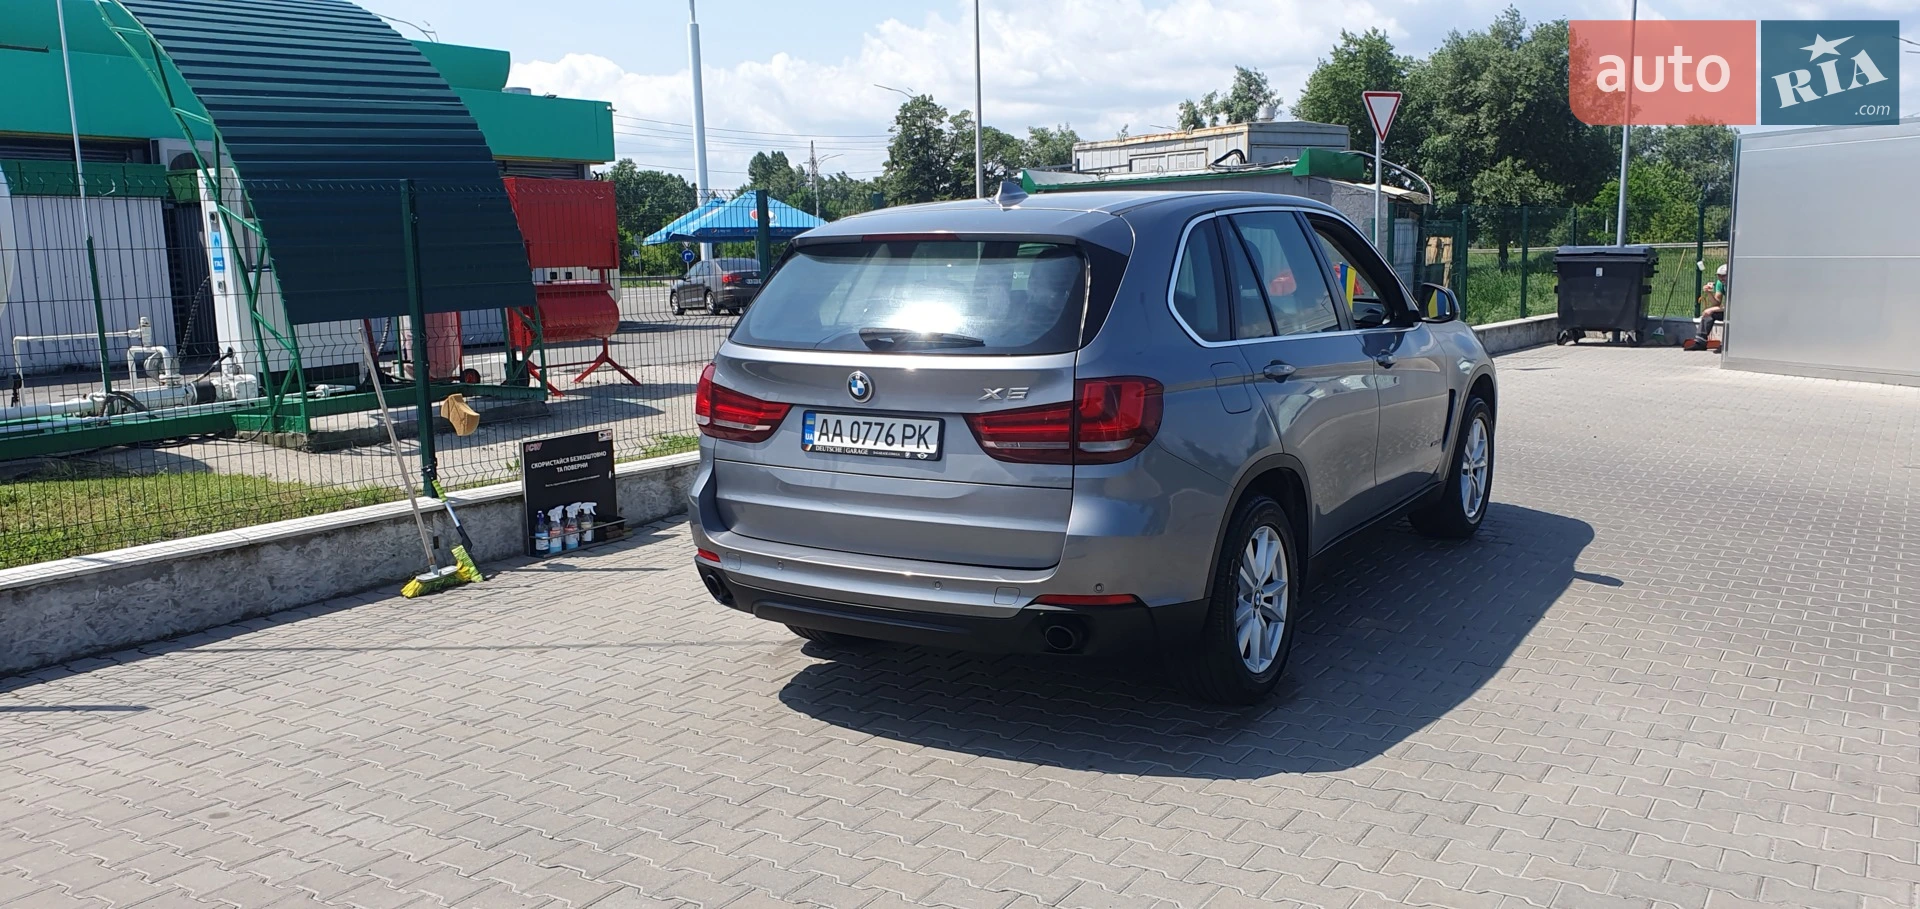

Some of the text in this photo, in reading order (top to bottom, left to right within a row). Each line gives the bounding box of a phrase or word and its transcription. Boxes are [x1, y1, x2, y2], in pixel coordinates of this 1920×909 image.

[977, 386, 1030, 401] X5
[805, 433, 814, 441] UA
[817, 418, 933, 450] AA 0776 PK
[815, 445, 843, 454] DEUTSCHE
[845, 447, 869, 455] GARAGE
[531, 451, 606, 469] СКОРИСТАЙСЯ БЕЗКОШТОВНО
[563, 462, 588, 471] ПОВЕРНИ
